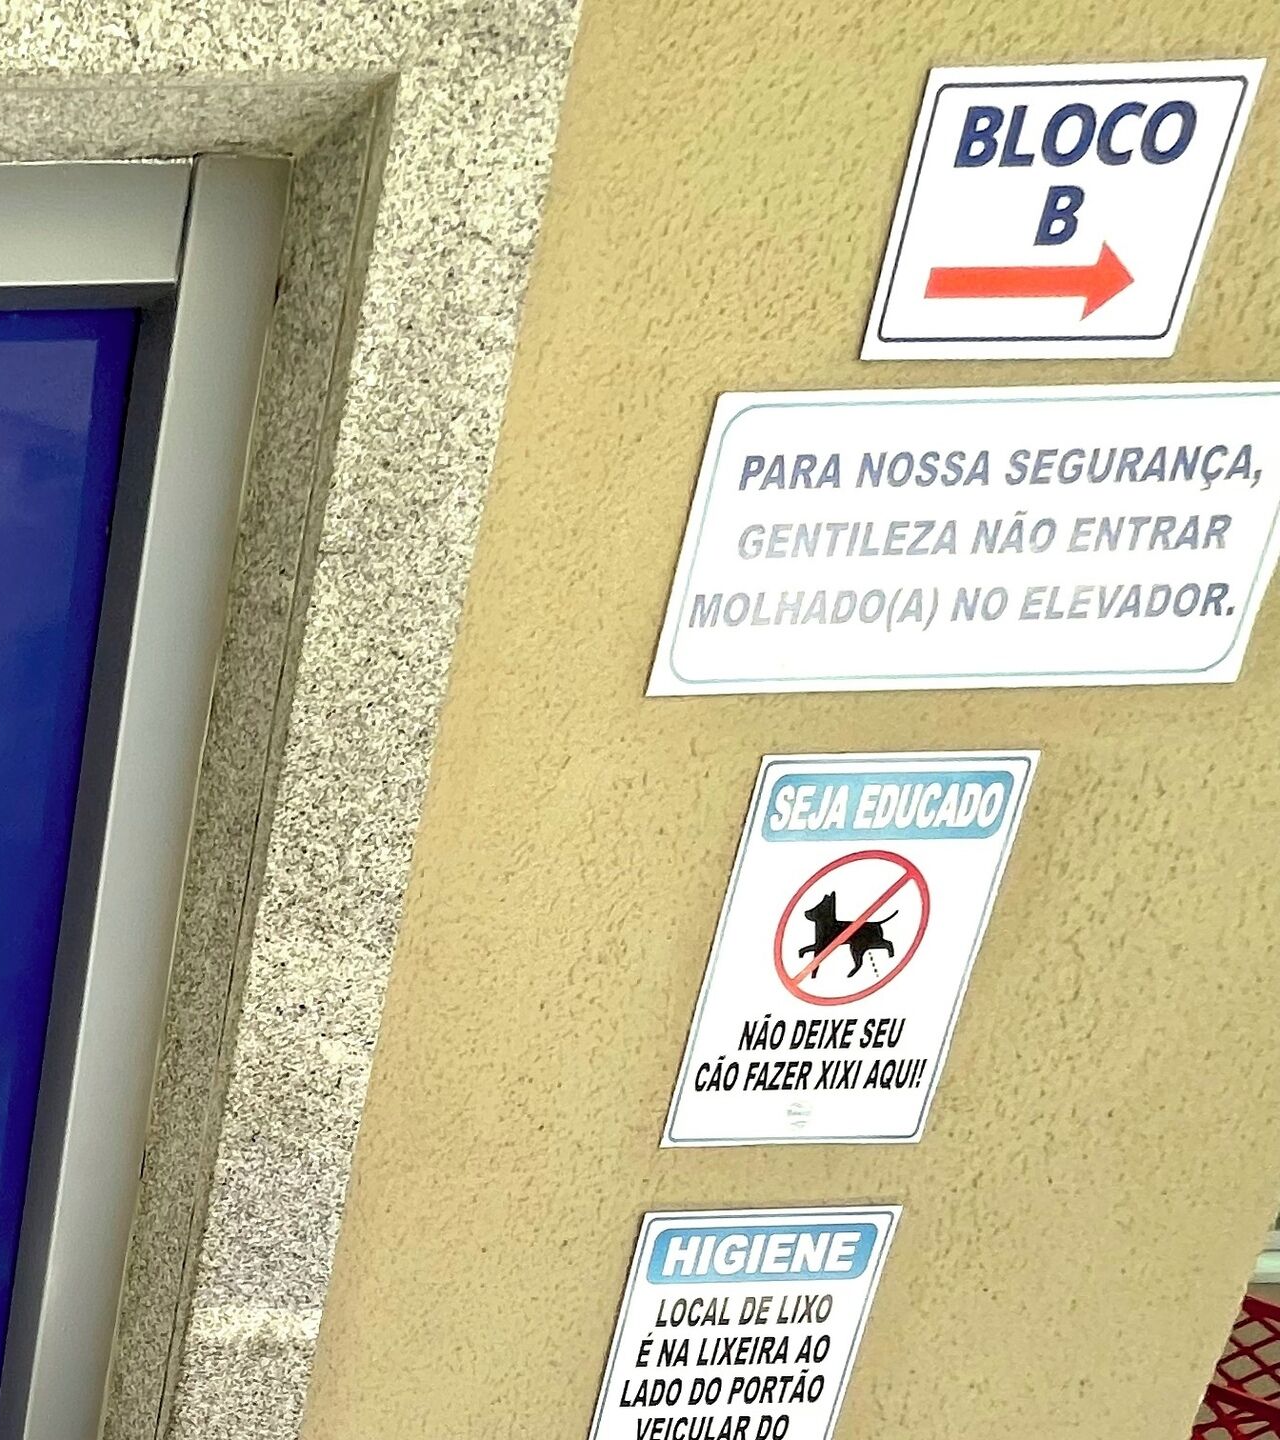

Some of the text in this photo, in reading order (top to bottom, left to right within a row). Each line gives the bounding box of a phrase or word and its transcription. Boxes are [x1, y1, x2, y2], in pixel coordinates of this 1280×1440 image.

[954, 100, 1197, 168] BLOCO
[1033, 185, 1085, 246] B
[738, 443, 1263, 491] PARA NOSSA SEGURANÇA,
[737, 511, 1234, 560] GENTILEZA NÃO ENTRAR
[687, 581, 1236, 632] MOLHADO(A) NO ELEVADOR.
[769, 781, 1005, 832] SEJA EDUCADO
[739, 1014, 907, 1051] NÃO DEIXE SEU
[695, 1057, 928, 1092] CÃO FAZER XIXI AQUI!
[662, 1231, 862, 1277] HIGIENE
[655, 1294, 833, 1328] LOCAL DE LIXO
[636, 1332, 831, 1368] É NA LIXEIRA AO
[619, 1369, 825, 1408] LADO DO PORTÃO
